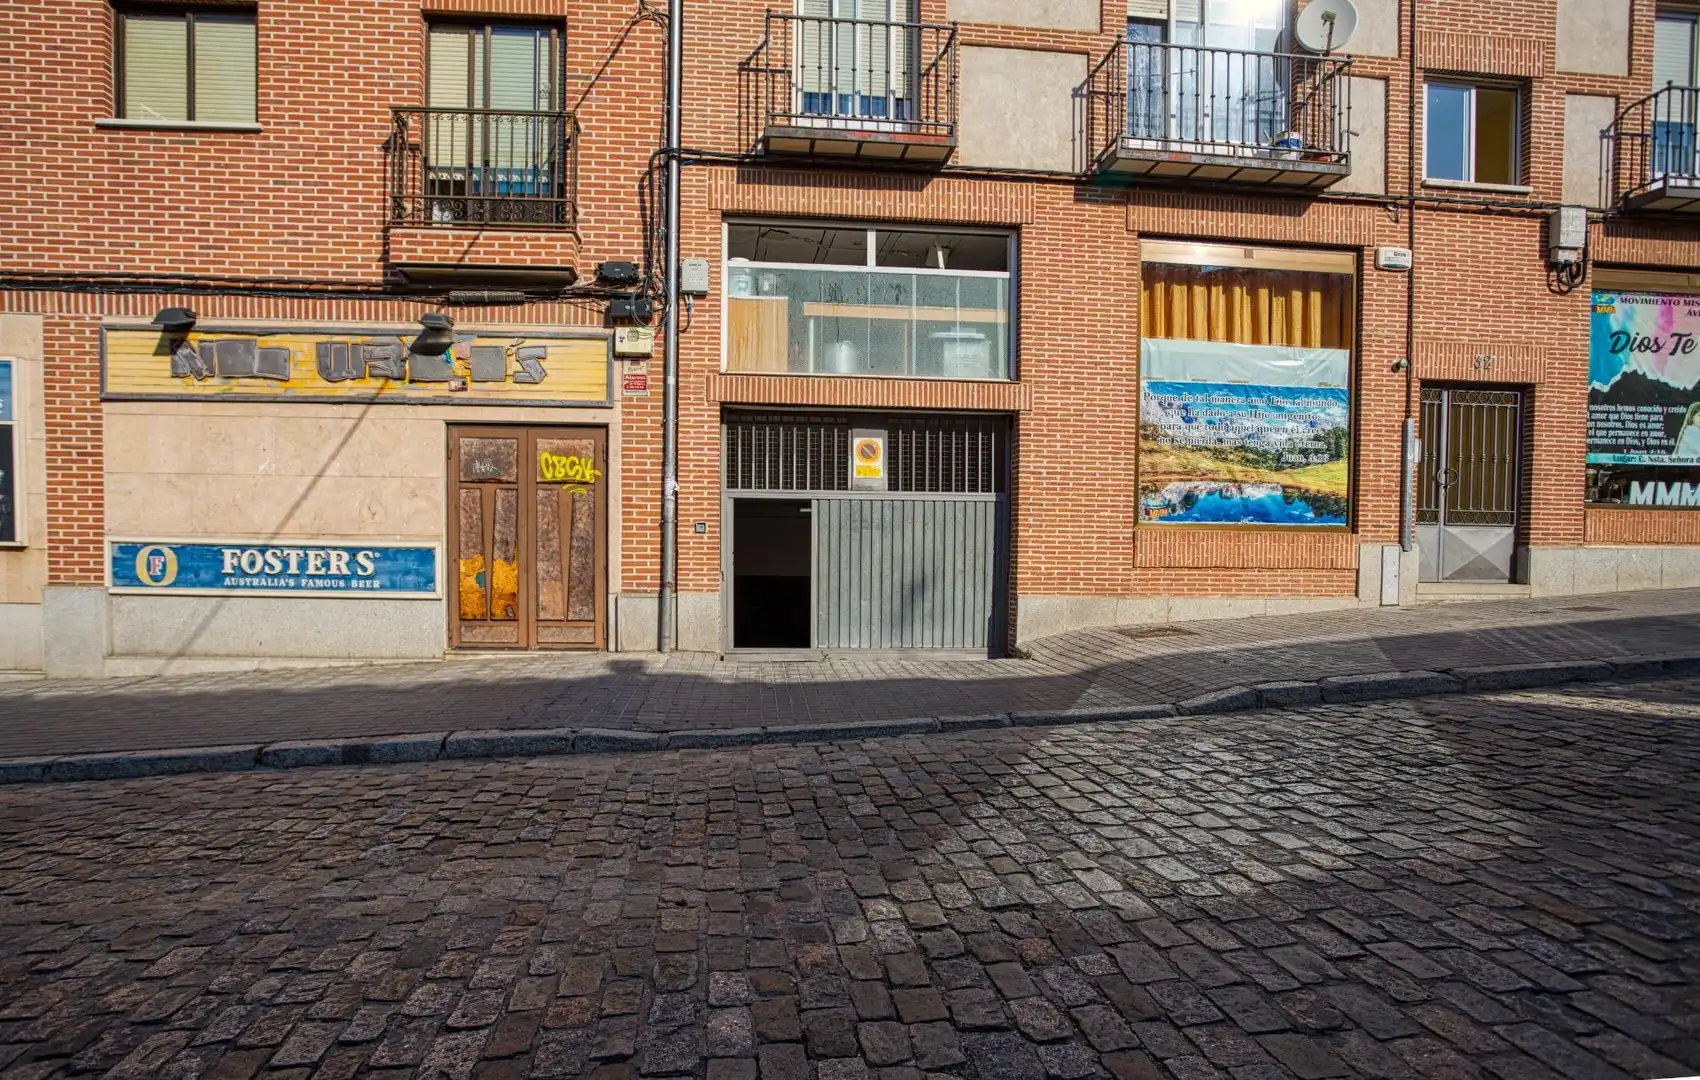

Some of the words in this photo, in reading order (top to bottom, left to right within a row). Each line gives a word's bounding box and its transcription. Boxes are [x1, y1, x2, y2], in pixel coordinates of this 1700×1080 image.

[1620, 297, 1681, 306] MOVIMIENTO
[1609, 330, 1666, 355] Dios
[1668, 332, 1698, 356] Te
[1143, 392, 1178, 406] Porque
[1181, 392, 1193, 402] de
[1196, 393, 1209, 403] tal
[1211, 396, 1246, 404] manera
[1271, 396, 1293, 407] Dios
[1294, 397, 1304, 407] al
[1167, 408, 1186, 418] que
[1188, 407, 1200, 417] ha
[1202, 407, 1225, 417] dado
[1236, 410, 1247, 418] su
[1248, 408, 1270, 419] Hijo
[1589, 404, 1615, 412] nosotros
[1616, 404, 1636, 412] hemos
[1637, 405, 1663, 413] conocido
[1663, 406, 1668, 415] y
[1608, 413, 1620, 422] que
[1620, 412, 1634, 420] Dios
[1634, 412, 1649, 421] tiene
[1650, 414, 1664, 422] para
[1160, 424, 1181, 432] para
[1185, 424, 1201, 432] que
[1204, 423, 1227, 432] todo
[1229, 424, 1254, 433] aquel
[1257, 425, 1275, 435] que
[1625, 420, 1638, 429] Dios
[1595, 429, 1608, 438] que
[1608, 430, 1640, 438] permanece
[1158, 437, 1172, 445] no
[1174, 437, 1185, 445] se
[1243, 439, 1270, 448] tenga
[1586, 437, 1616, 445] ermanece
[1646, 437, 1660, 446] Dios
[1613, 454, 1637, 464] Lugar:
[221, 549, 377, 577] FOSTER'S
[223, 577, 296, 588] AUSTRALIA'S
[301, 579, 345, 589] FAMOUS
[351, 579, 381, 590] BEER
